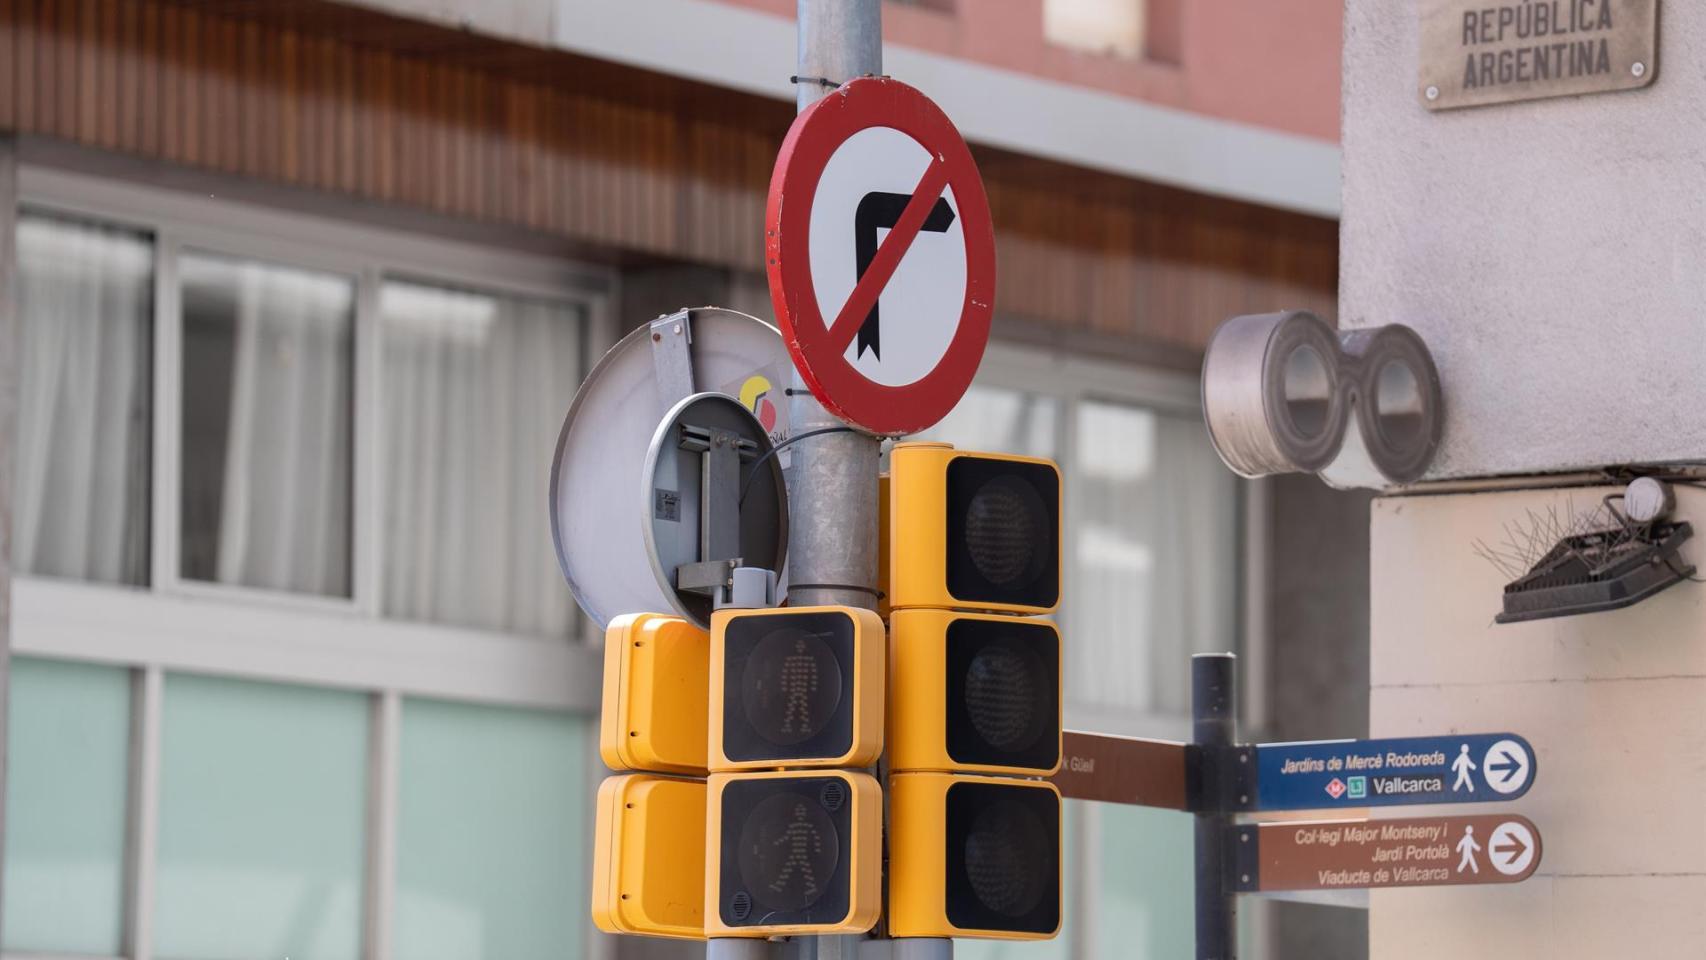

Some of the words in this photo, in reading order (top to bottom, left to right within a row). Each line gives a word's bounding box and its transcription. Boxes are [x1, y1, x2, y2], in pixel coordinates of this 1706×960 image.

[1463, 0, 1612, 45] REPÚBLICA
[1463, 38, 1610, 89] ARGENTINA
[1281, 756, 1324, 774] Jardins
[1327, 756, 1342, 771] de
[1345, 753, 1383, 770] Mercè
[1386, 751, 1445, 767] Rodoreda
[1373, 777, 1442, 794] Vallcarca
[1343, 826, 1379, 845] Major
[1381, 825, 1441, 841] Montseny
[1371, 846, 1404, 862] Jardí
[1406, 844, 1450, 860] Portolà
[1318, 870, 1370, 885] Viaducte
[1373, 868, 1389, 883] de
[1392, 866, 1449, 882] Vallcarca
